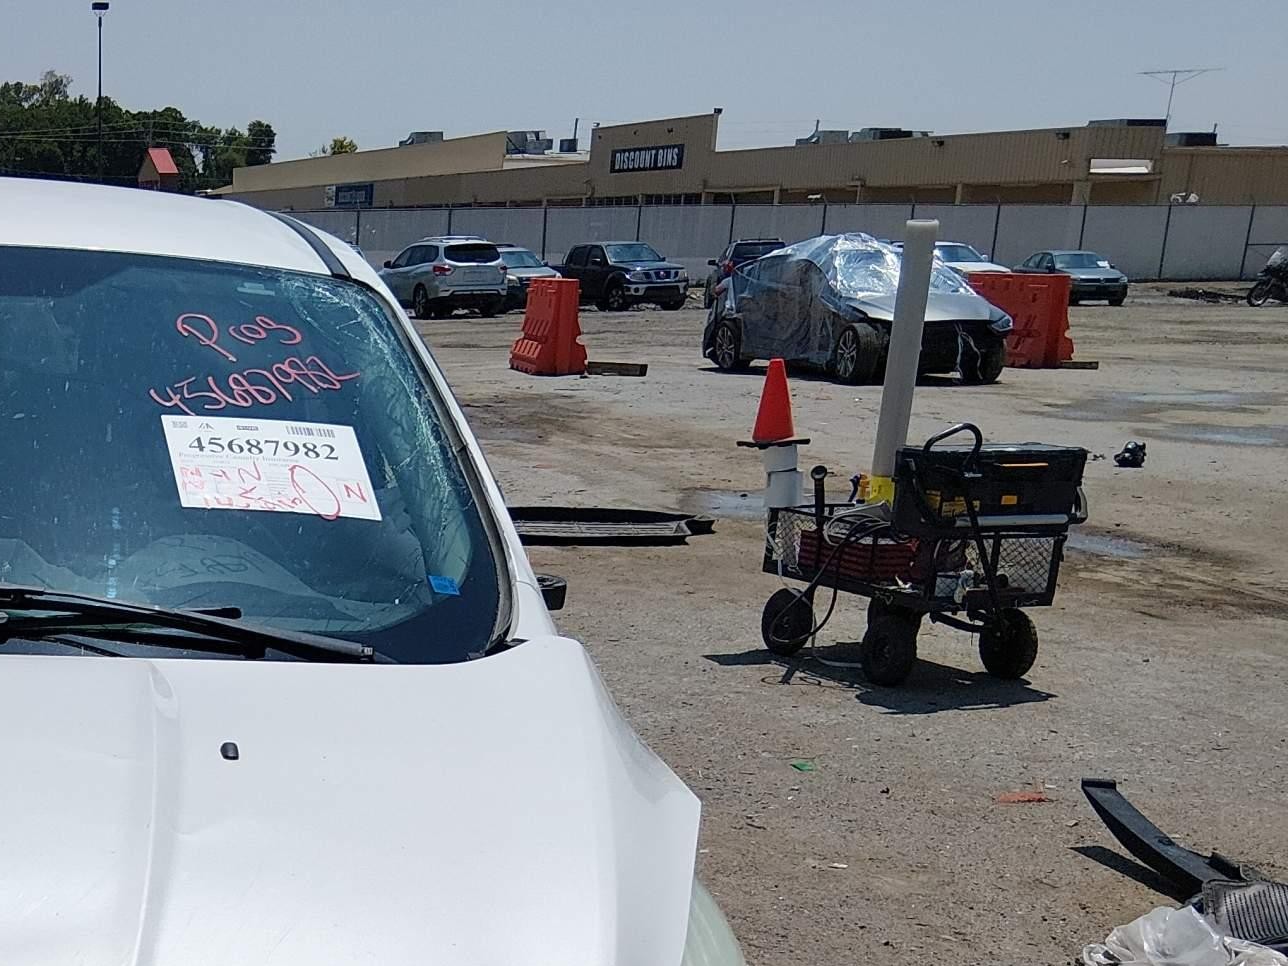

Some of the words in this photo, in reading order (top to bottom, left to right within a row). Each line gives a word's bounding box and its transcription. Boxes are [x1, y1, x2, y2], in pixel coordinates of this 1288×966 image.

[615, 150, 656, 170] DISCOUNT
[657, 148, 679, 167] BINS
[149, 355, 361, 415] 45687982
[188, 435, 339, 461] 45687982
